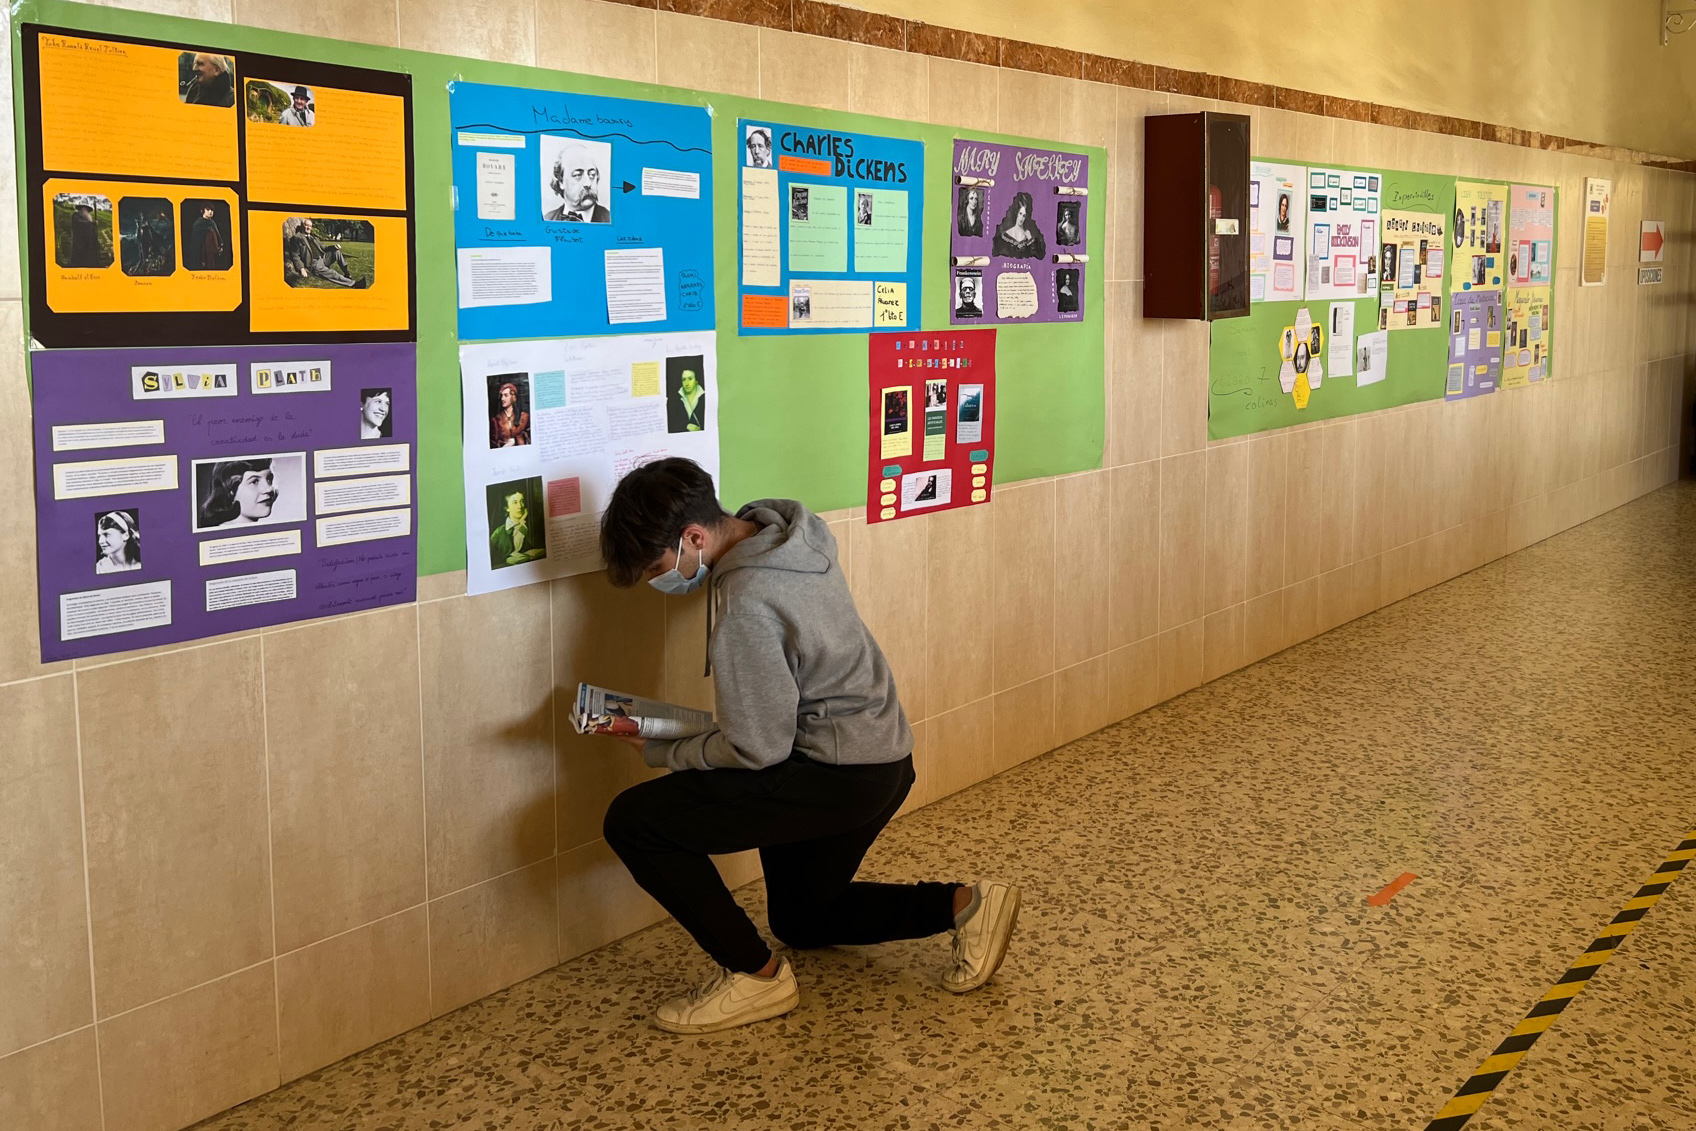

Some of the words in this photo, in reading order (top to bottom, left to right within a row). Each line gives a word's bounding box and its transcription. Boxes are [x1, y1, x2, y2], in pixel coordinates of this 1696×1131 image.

[531, 104, 594, 125] Madame
[954, 146, 1001, 177] MARY
[1013, 151, 1082, 183] SHELLEY
[1330, 235, 1359, 247] DICKINSON
[231, 414, 265, 428] enemigo
[268, 412, 280, 422] de
[284, 411, 297, 421] la
[210, 435, 257, 446] creatividad
[278, 431, 287, 442] la
